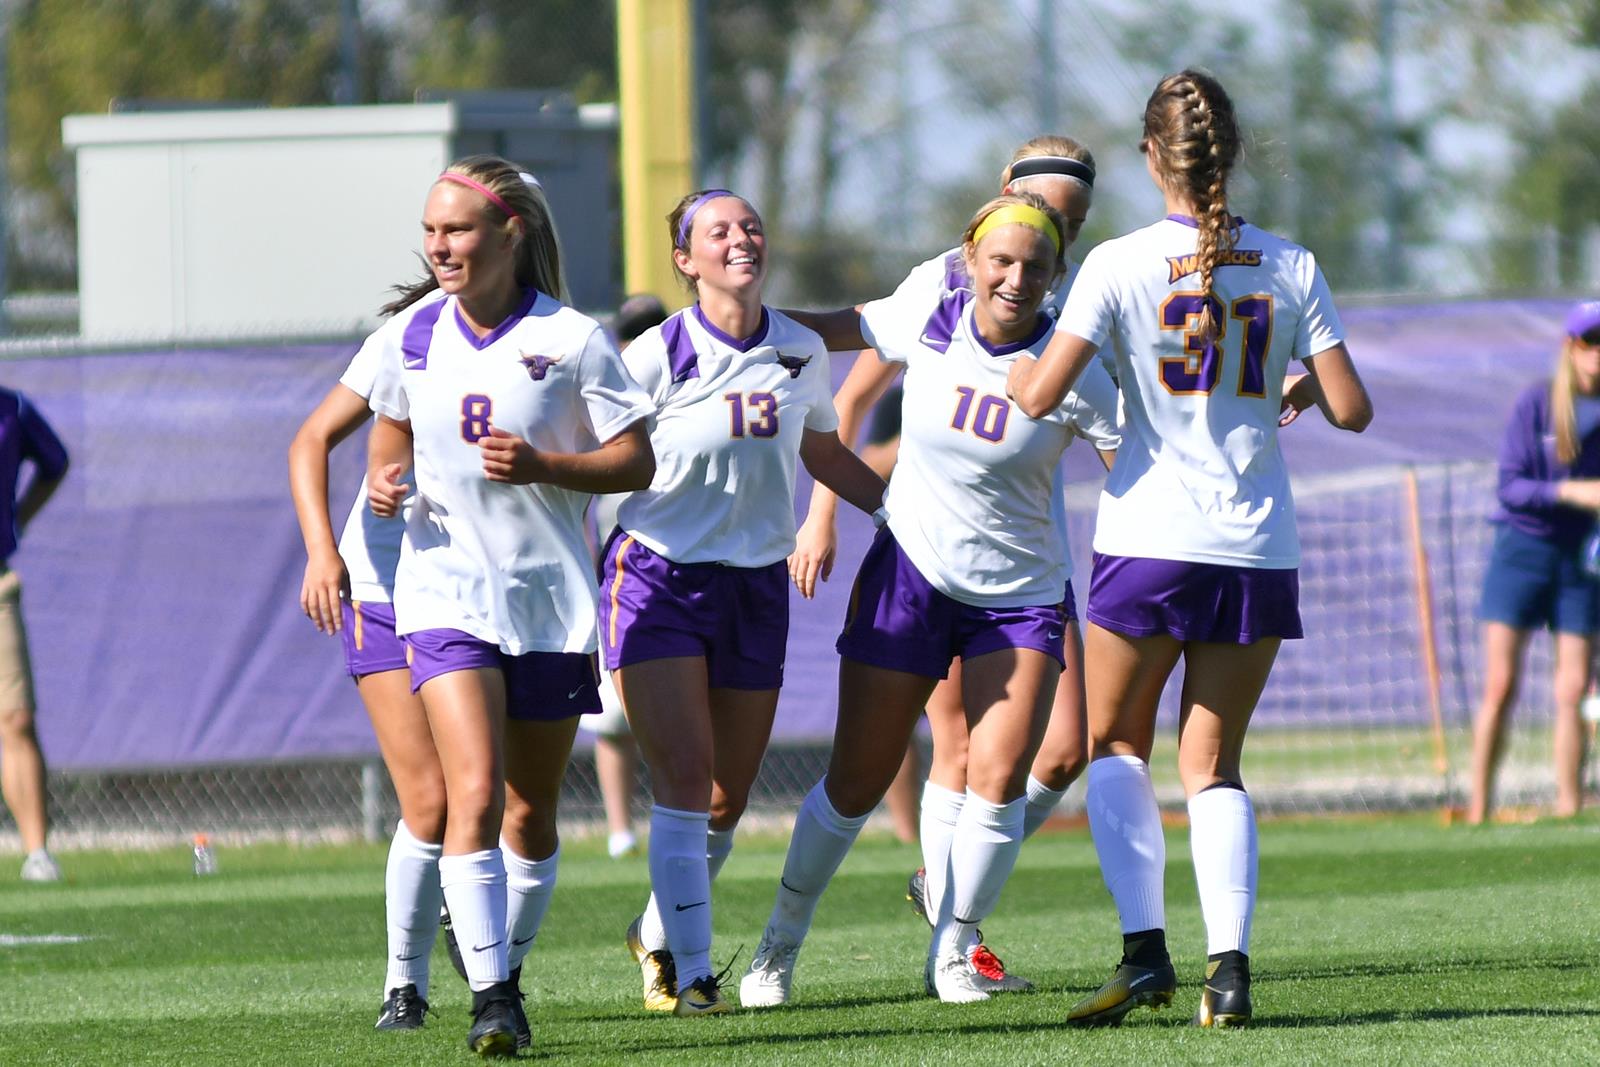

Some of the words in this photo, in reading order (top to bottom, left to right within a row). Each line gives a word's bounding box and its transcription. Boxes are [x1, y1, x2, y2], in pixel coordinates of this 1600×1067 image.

[1158, 291, 1274, 399] 31
[460, 392, 493, 445] 8
[724, 389, 780, 440] 13
[950, 384, 1011, 444] 10
